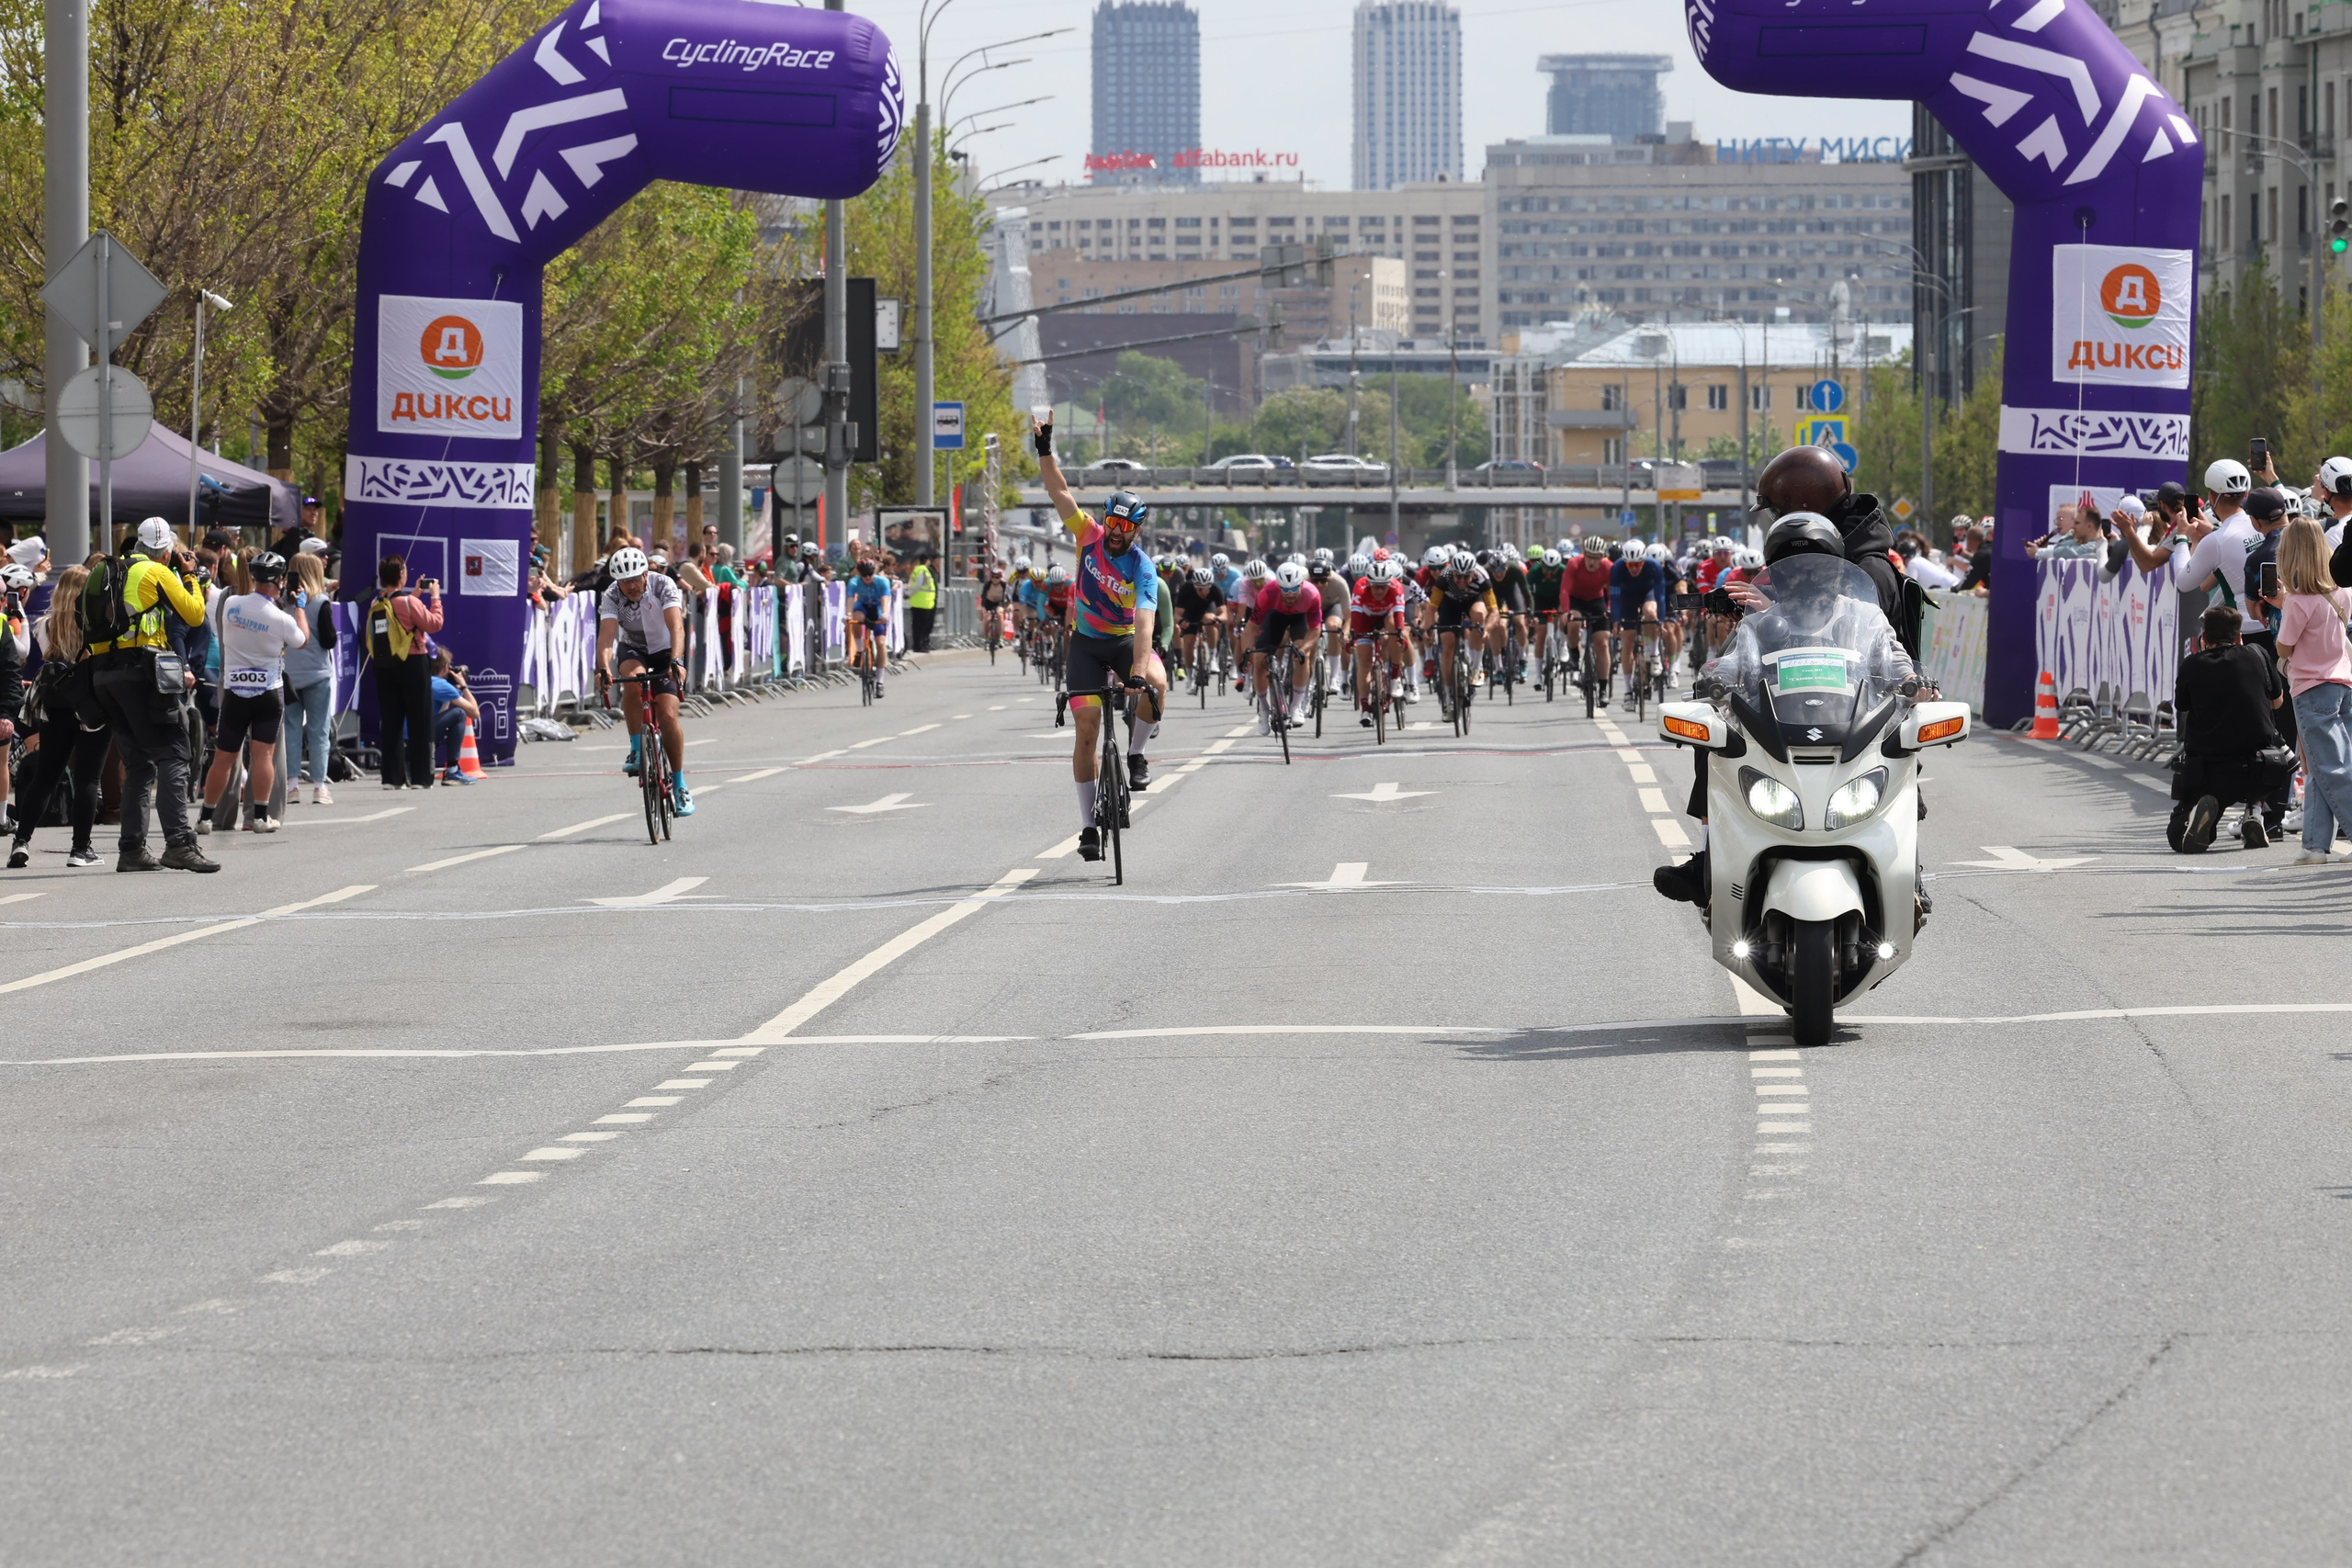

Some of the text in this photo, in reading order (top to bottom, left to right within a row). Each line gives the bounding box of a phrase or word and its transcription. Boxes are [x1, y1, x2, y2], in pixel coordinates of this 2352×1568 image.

[662, 38, 835, 72] CyclingRace
[1172, 148, 1298, 168] alfabank.ru
[1716, 138, 1806, 164] НИТУ
[2243, 533, 2262, 547] Skill
[230, 672, 266, 682] 3003
